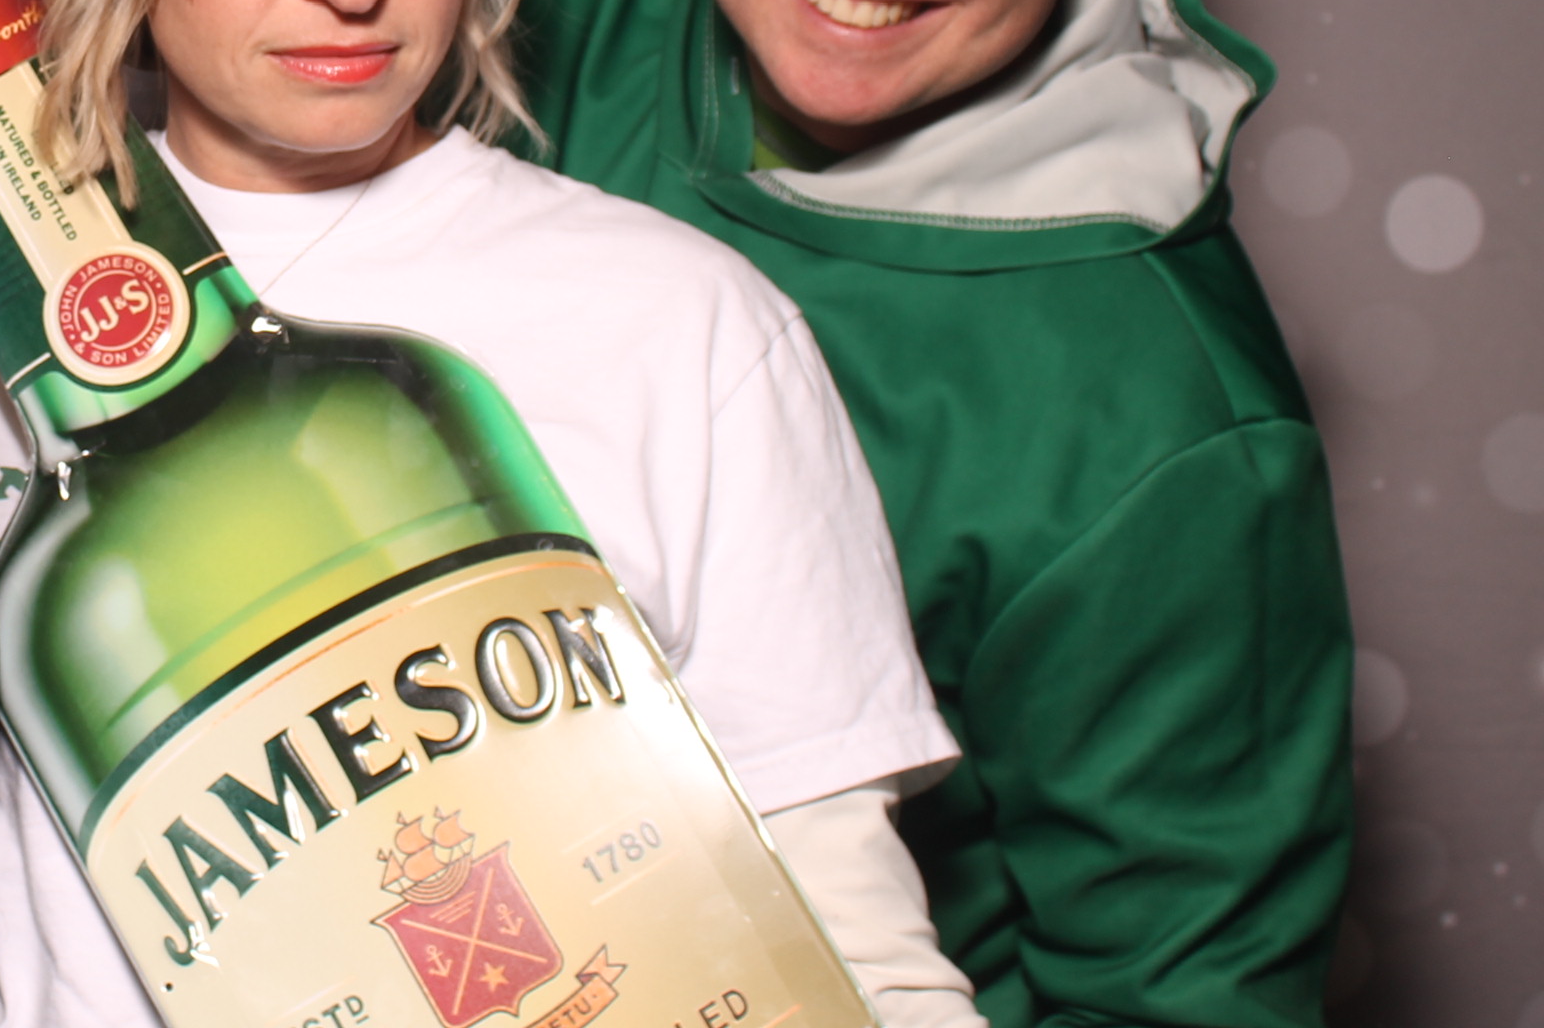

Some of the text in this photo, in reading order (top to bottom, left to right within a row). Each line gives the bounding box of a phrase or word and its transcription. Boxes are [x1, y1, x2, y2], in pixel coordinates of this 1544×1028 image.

[2, 162, 42, 221] IRELAND
[37, 181, 77, 241] BOTTLED
[61, 256, 158, 331] JOHN JAMESON
[79, 278, 150, 343] JJ&S
[90, 351, 128, 365] SON
[133, 293, 170, 357] LIMITED
[135, 606, 627, 967] JAMESON
[582, 821, 662, 884] 1780
